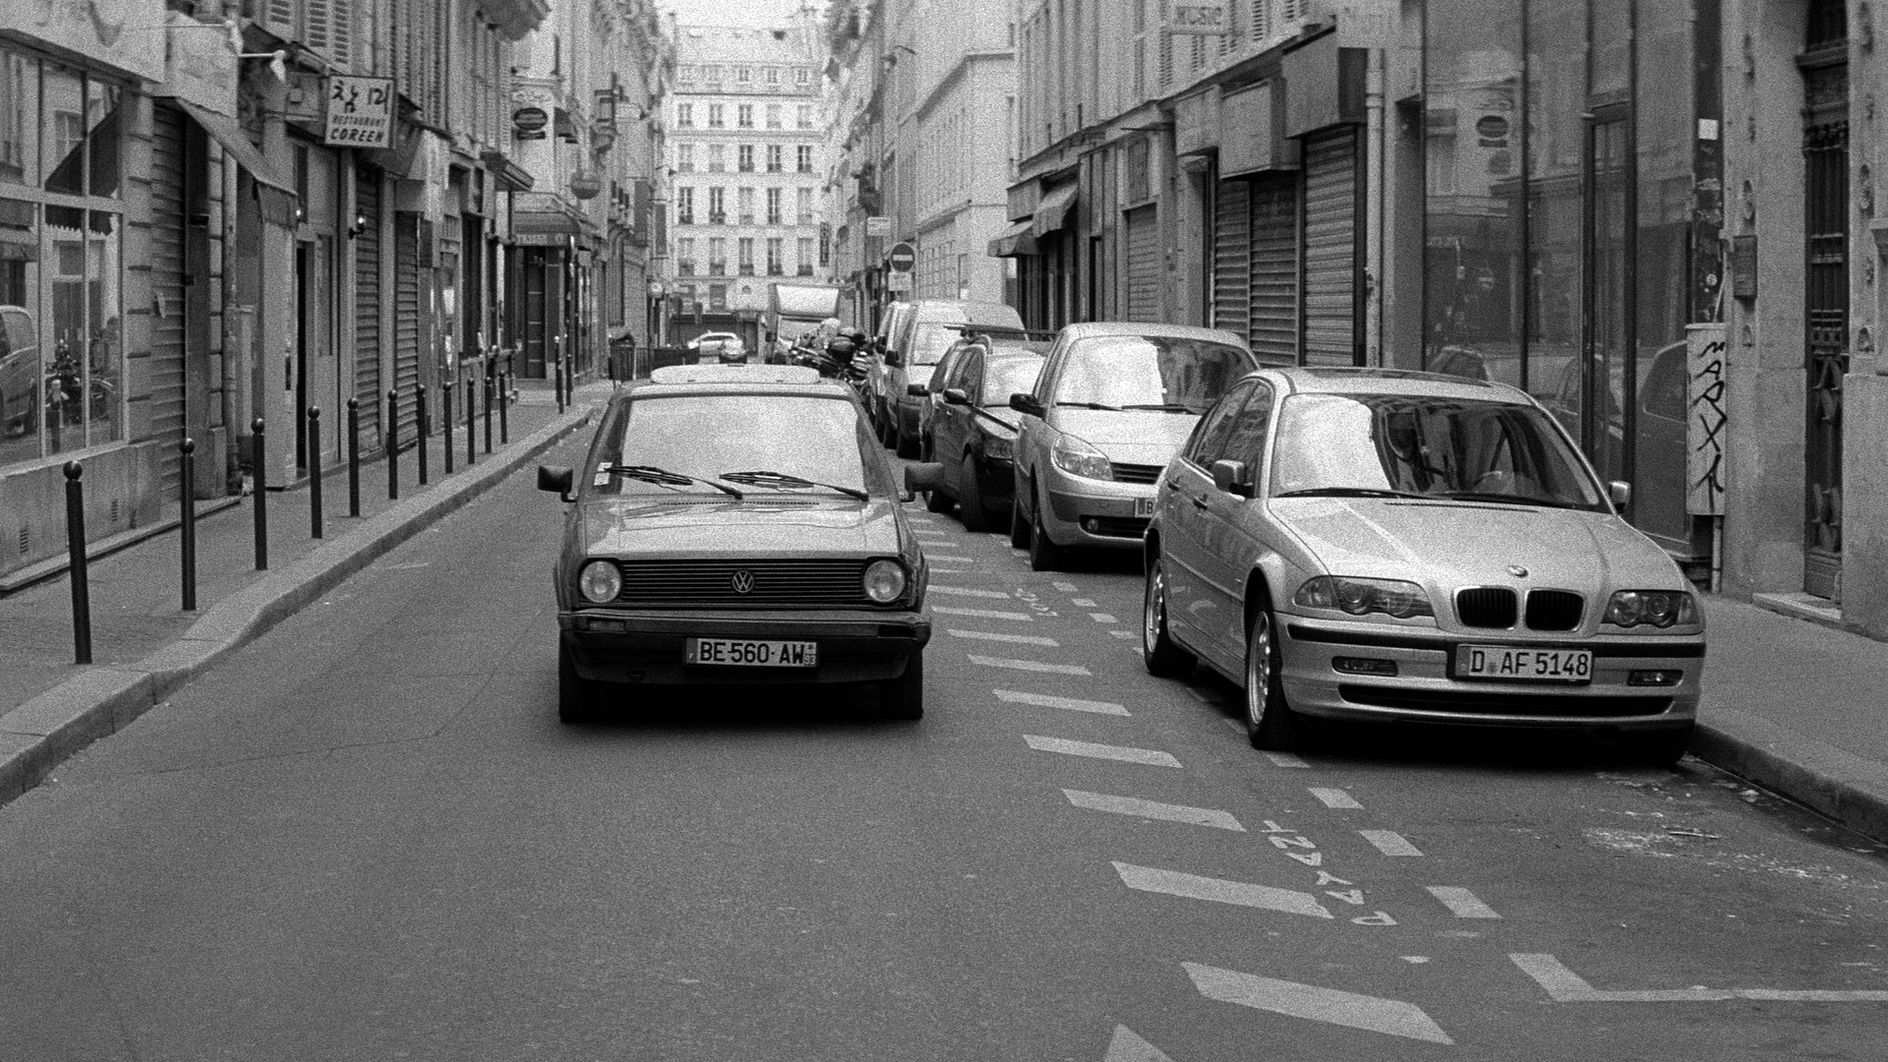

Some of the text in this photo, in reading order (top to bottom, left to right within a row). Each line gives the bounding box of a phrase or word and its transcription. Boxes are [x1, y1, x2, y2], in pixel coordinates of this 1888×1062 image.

[330, 128, 384, 143] COREEN
[1500, 651, 1530, 674] AF
[1535, 652, 1589, 676] 5148
[1260, 820, 1398, 926] PAYANT
